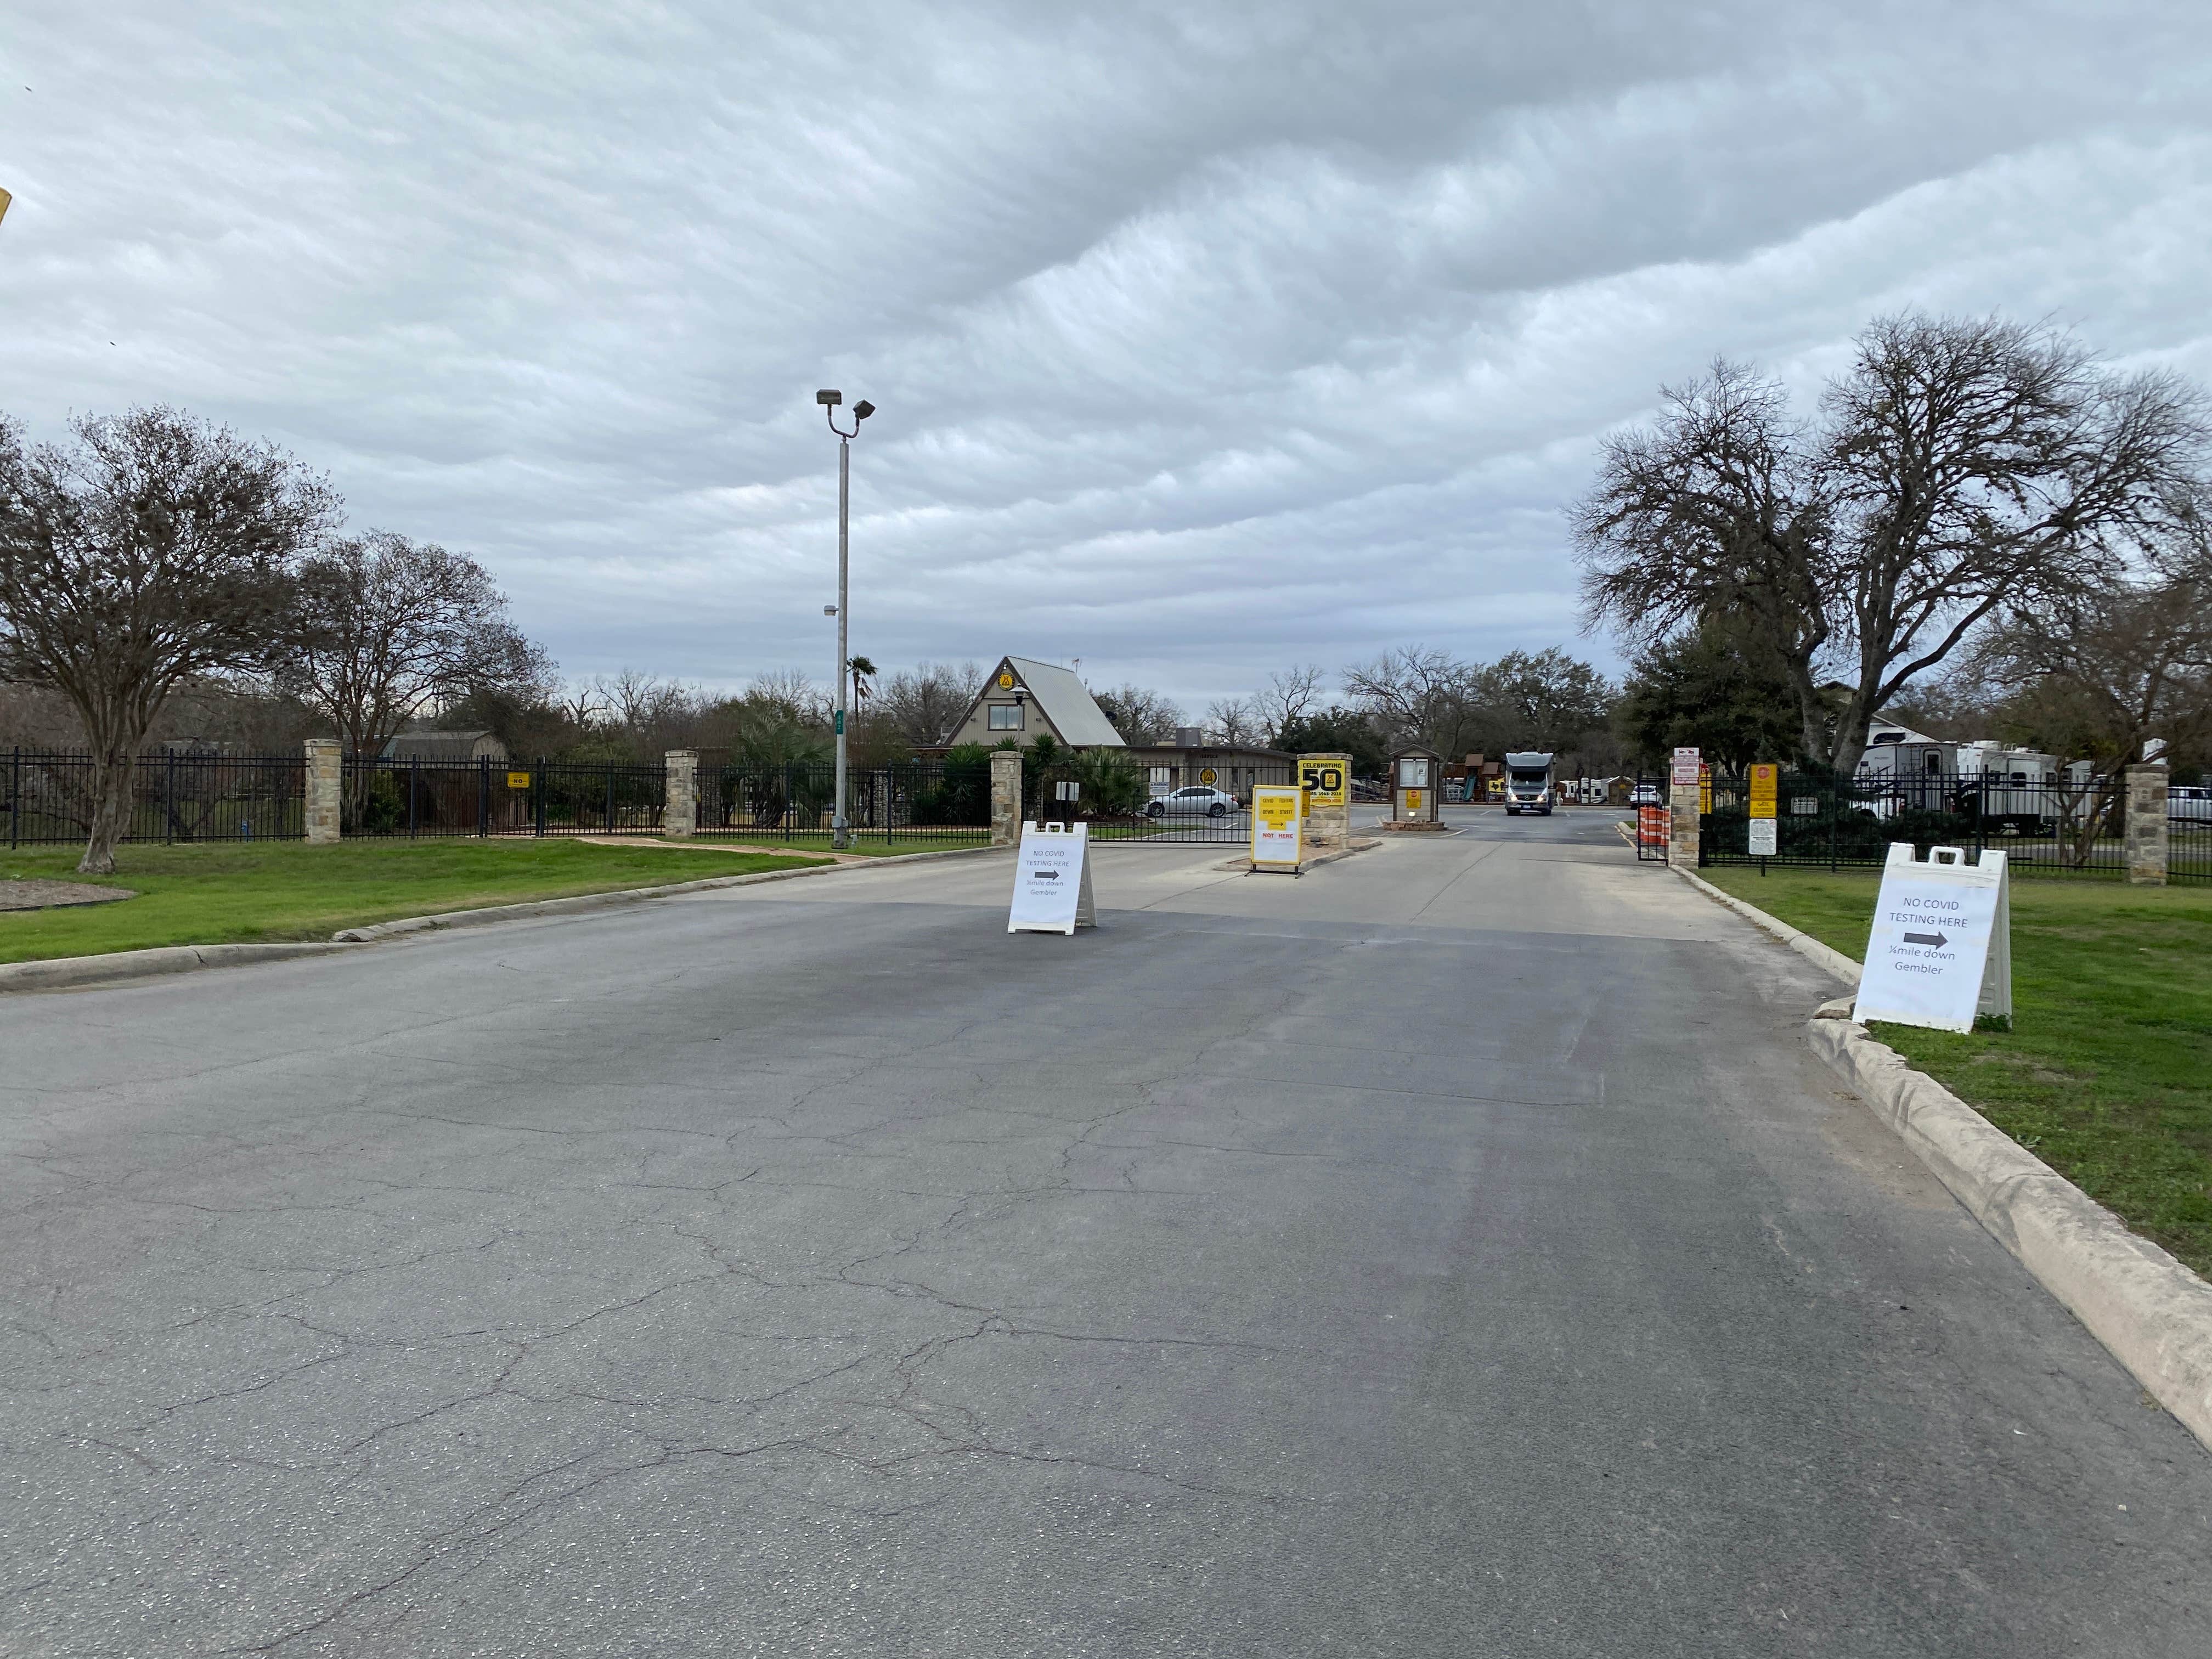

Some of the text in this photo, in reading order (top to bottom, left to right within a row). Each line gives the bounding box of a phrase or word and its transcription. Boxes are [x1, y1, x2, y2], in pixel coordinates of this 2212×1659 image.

[1302, 769, 1341, 791] 50
[1903, 898, 1959, 911] NO COVID
[1889, 912, 1968, 928] TESTING HERE
[1924, 946, 1955, 960] down
[1895, 961, 1943, 975] Gembler
